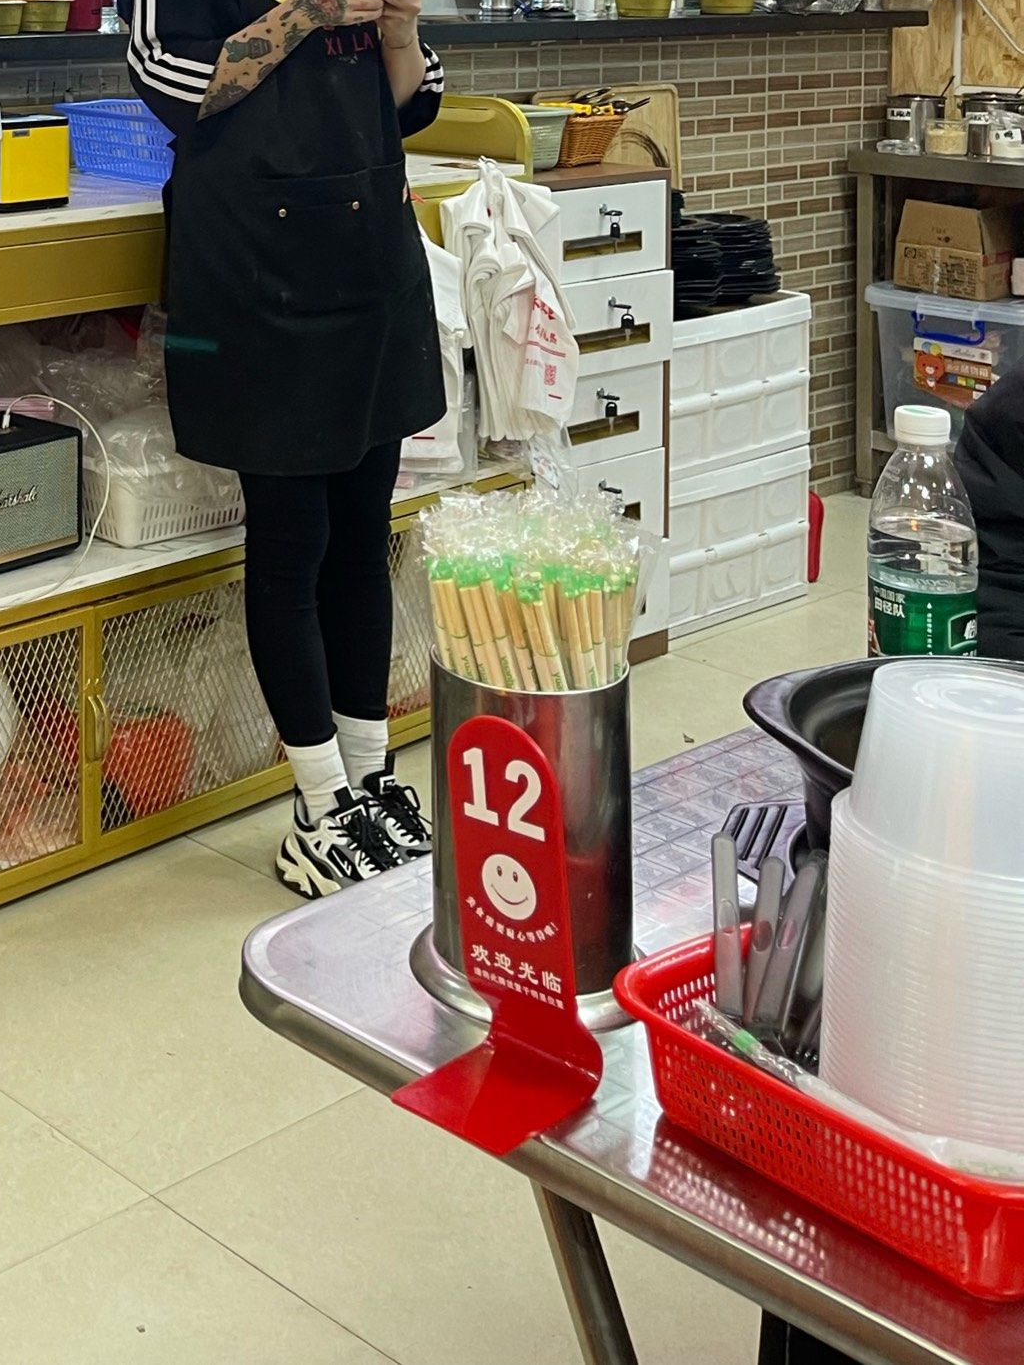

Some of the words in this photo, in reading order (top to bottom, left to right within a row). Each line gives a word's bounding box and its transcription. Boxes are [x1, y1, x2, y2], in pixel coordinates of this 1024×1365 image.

[874, 596, 906, 619] 田径队
[463, 747, 546, 843] 12
[470, 944, 562, 994] 欢迎光临
